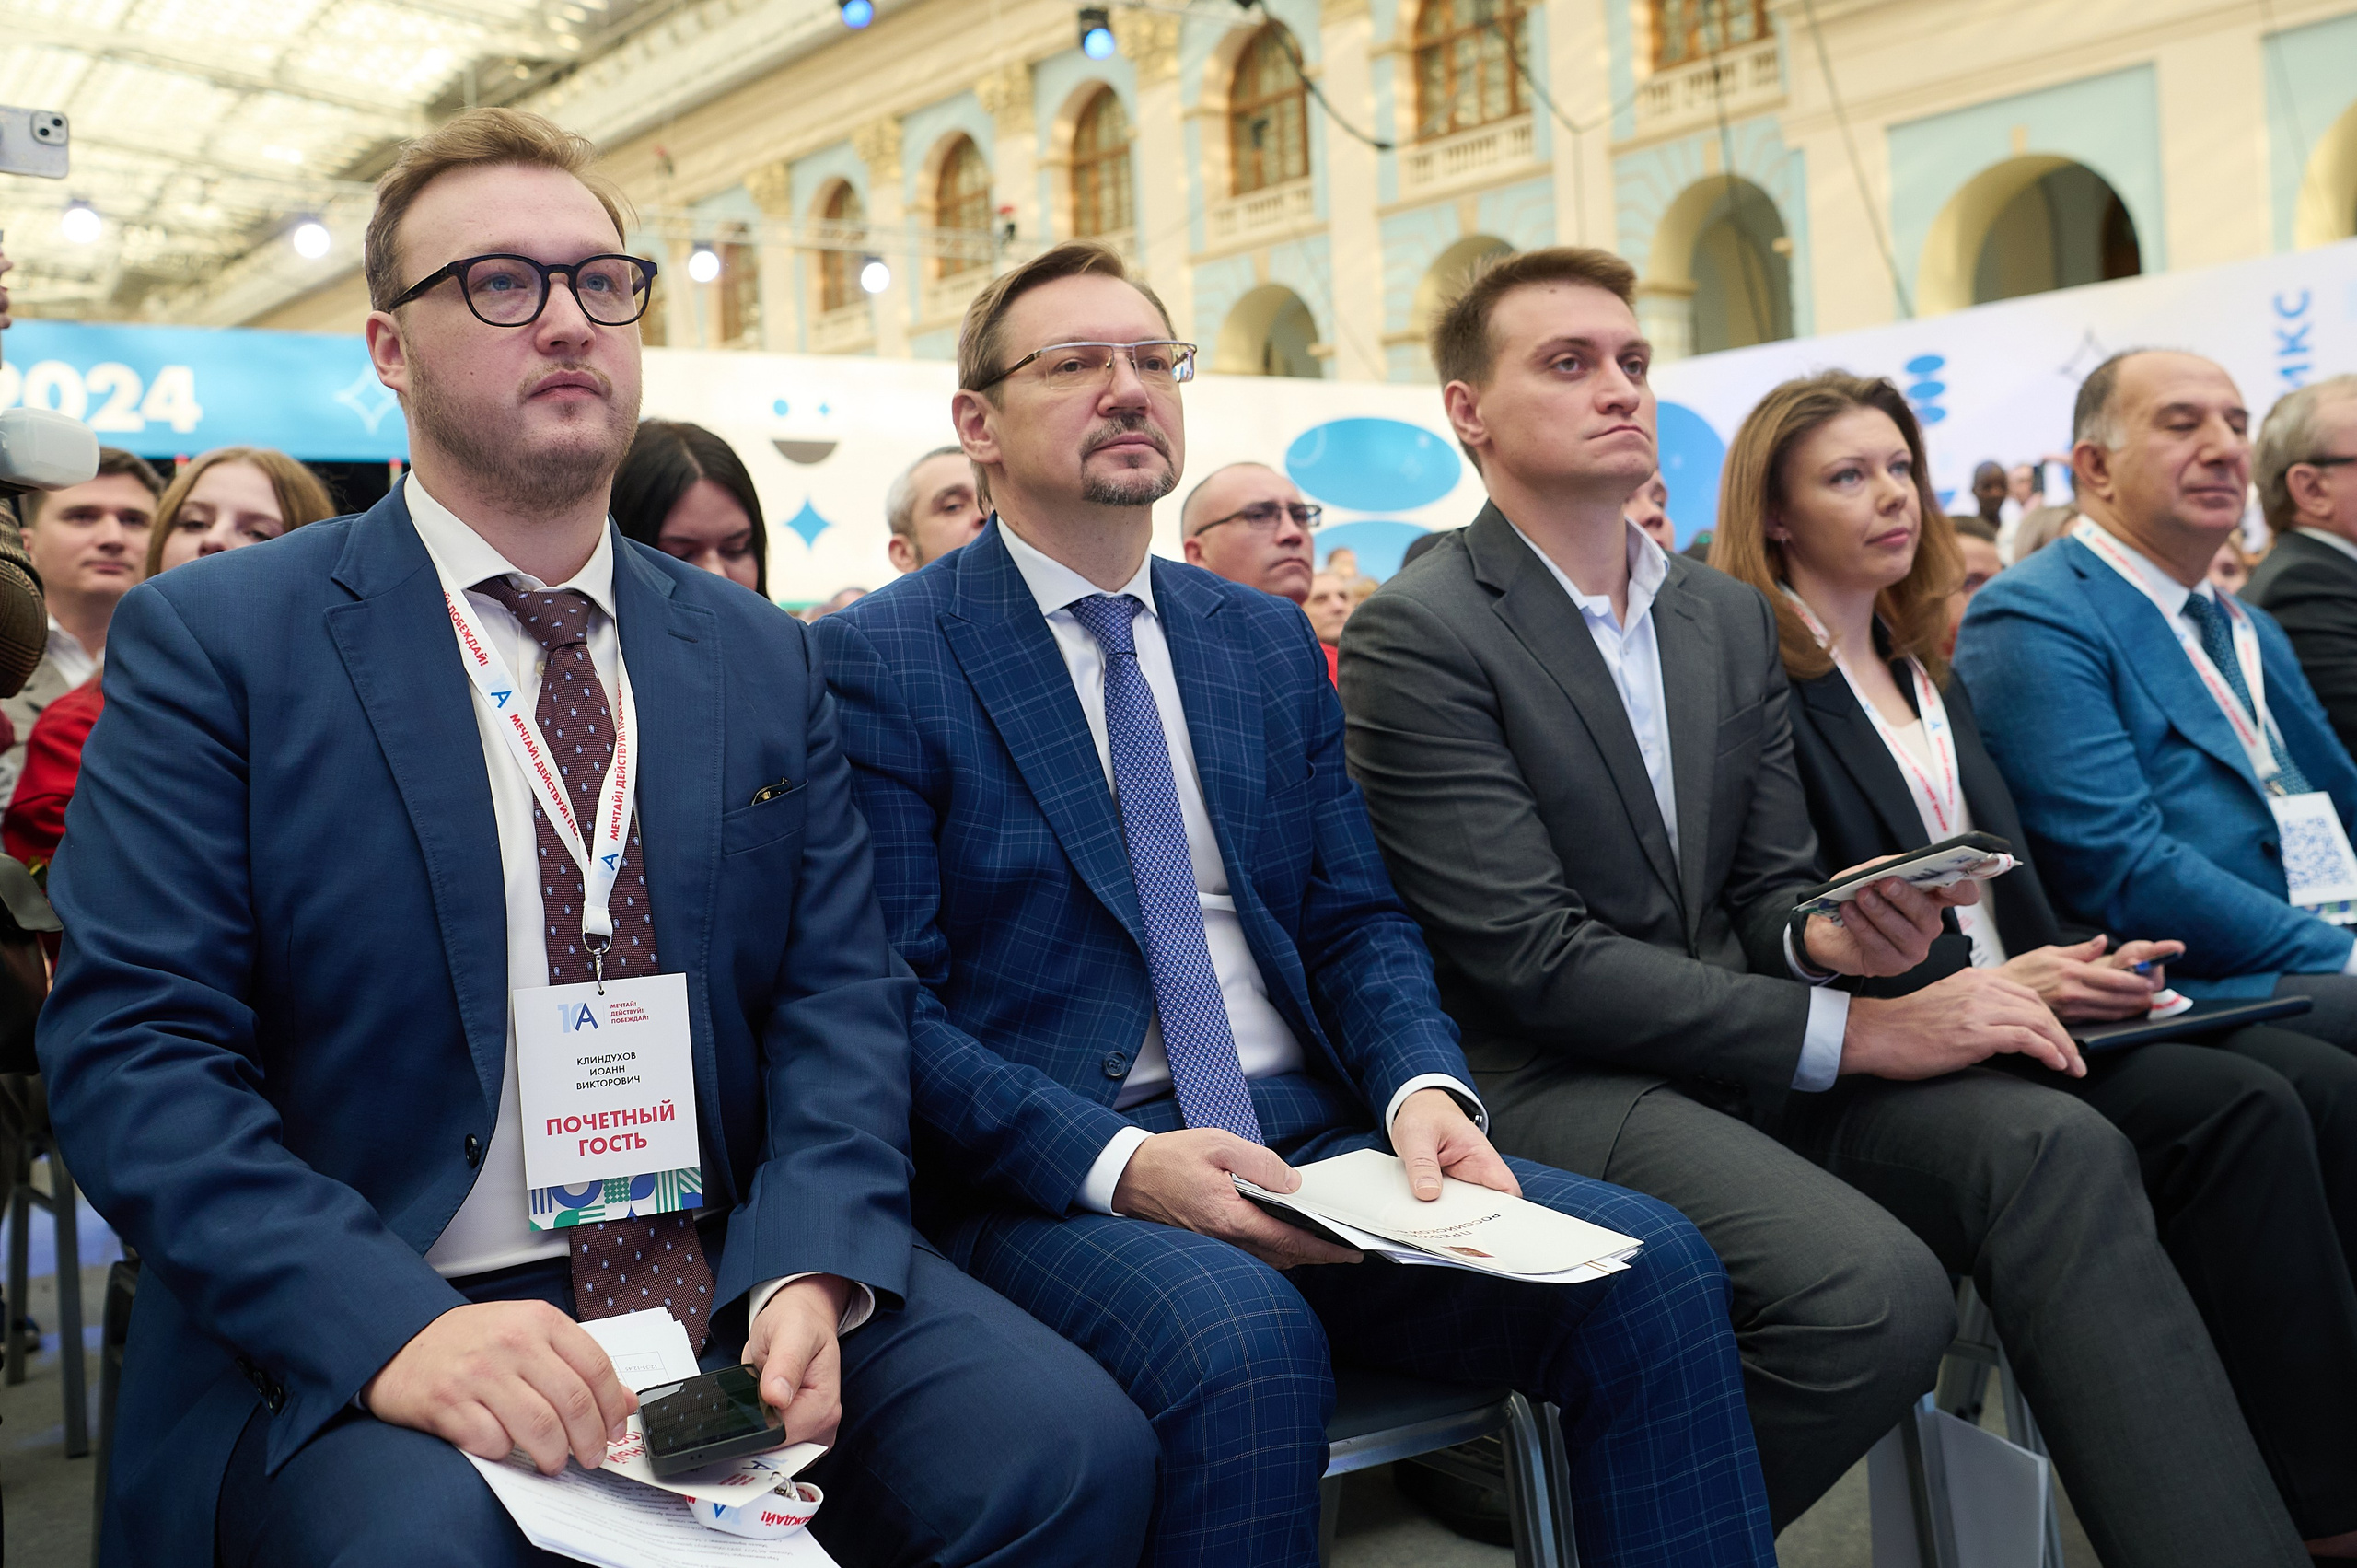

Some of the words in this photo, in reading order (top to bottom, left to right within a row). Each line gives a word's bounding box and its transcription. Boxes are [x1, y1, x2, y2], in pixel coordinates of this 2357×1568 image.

[447, 604, 489, 667] ПОБЕЖДАЙ!
[509, 713, 540, 761] МЕЧТАЙ!
[534, 760, 570, 819] ДЕЙСТВУЙ!
[614, 729, 628, 789] ДЕЙСТВУЙ!
[610, 790, 625, 842] МЕЧТАЙ!
[610, 1000, 637, 1009] МЕЧТАЙ!
[610, 1007, 644, 1017] ДЕЙСТВУЙ!
[610, 1014, 649, 1024] ПОБЕЖДАЙ!
[576, 1051, 637, 1065] КЛИНДУХОВ
[589, 1065, 625, 1076] ИОАНН
[576, 1075, 641, 1090] ВИКТОРОВИЧ
[546, 1098, 676, 1136] ПОЧЕТНЫЙ
[578, 1132, 648, 1156] ГОСТЬ
